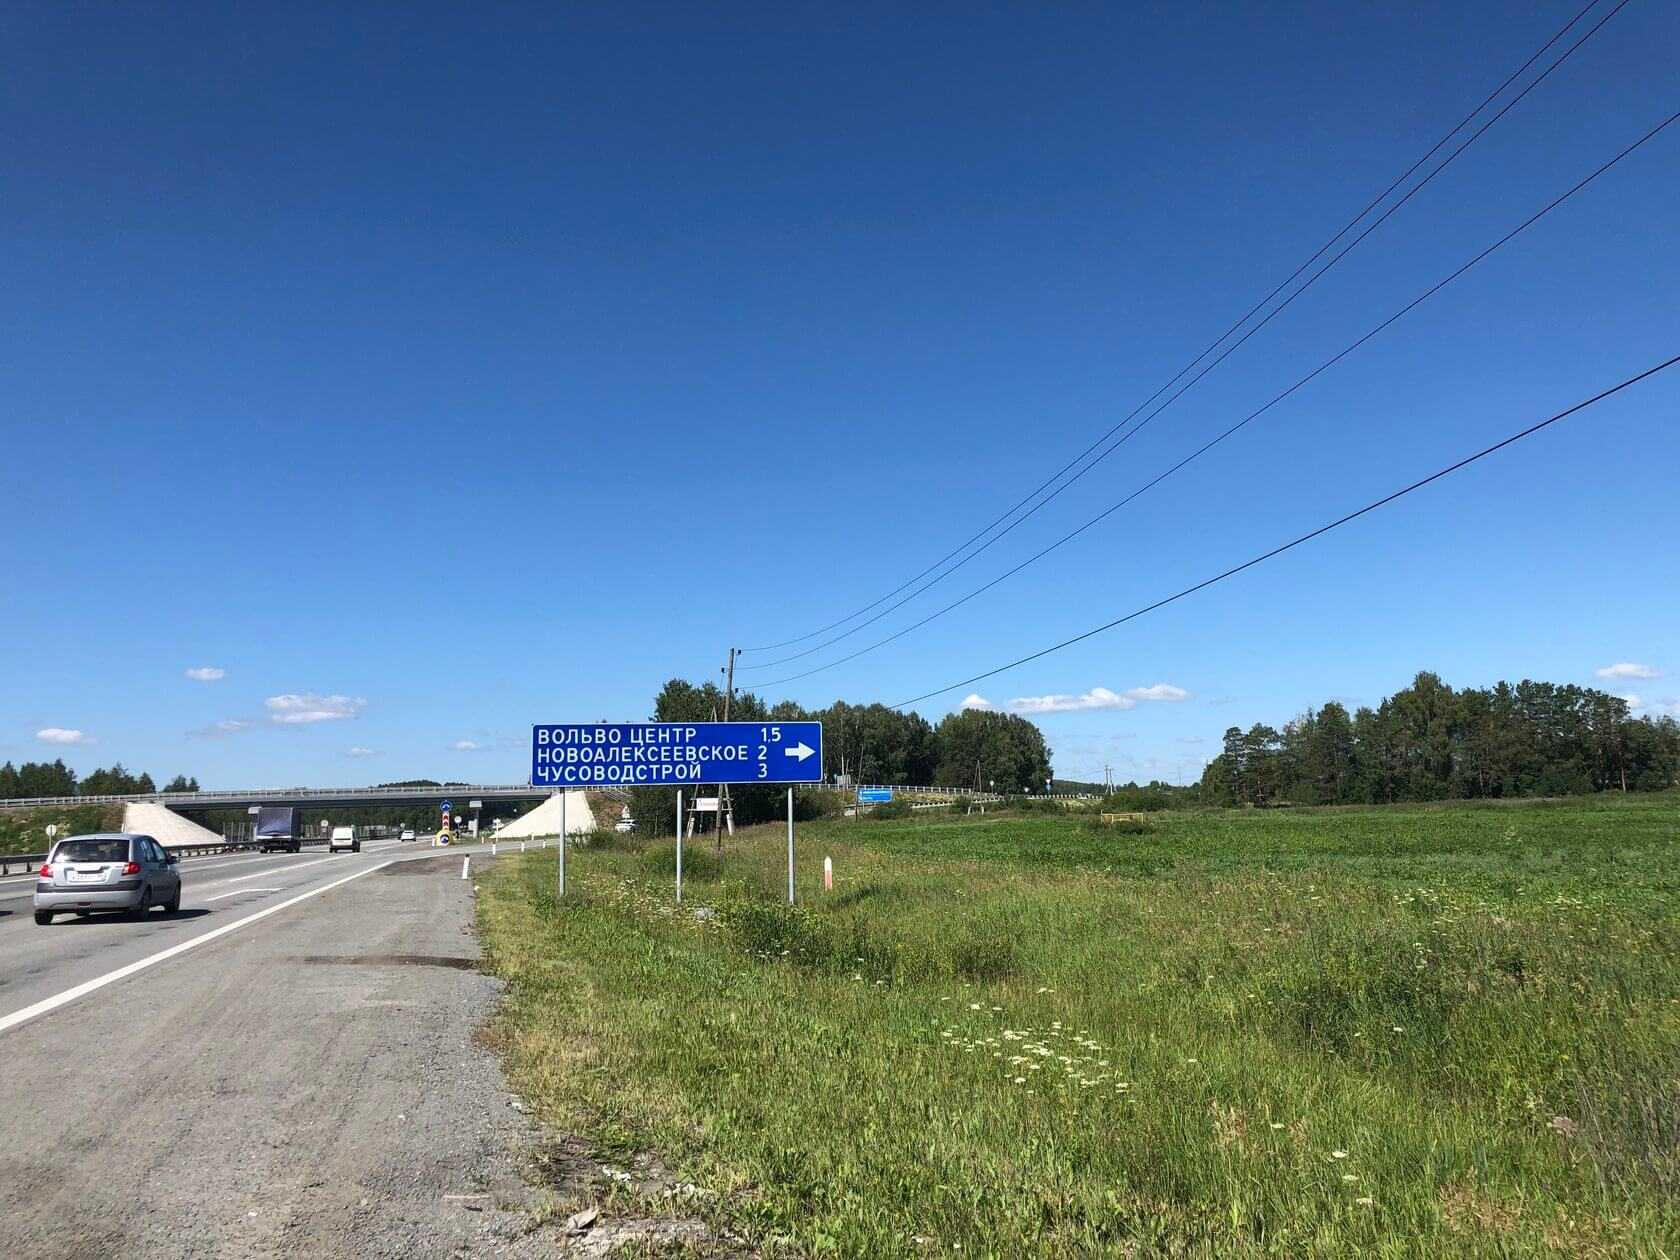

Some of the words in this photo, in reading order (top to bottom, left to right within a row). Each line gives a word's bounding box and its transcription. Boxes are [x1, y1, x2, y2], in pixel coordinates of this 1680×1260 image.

[537, 728, 621, 745] ВОЛЬВО
[630, 727, 697, 747] ЦЕНТР
[760, 727, 782, 743] 1,5
[537, 745, 748, 763] НОВОАЛЕКСЕЕВСКОЕ
[757, 745, 768, 760] 2
[537, 761, 701, 782] ЧУСОВОДСТРОЙ
[758, 763, 768, 778] 3
